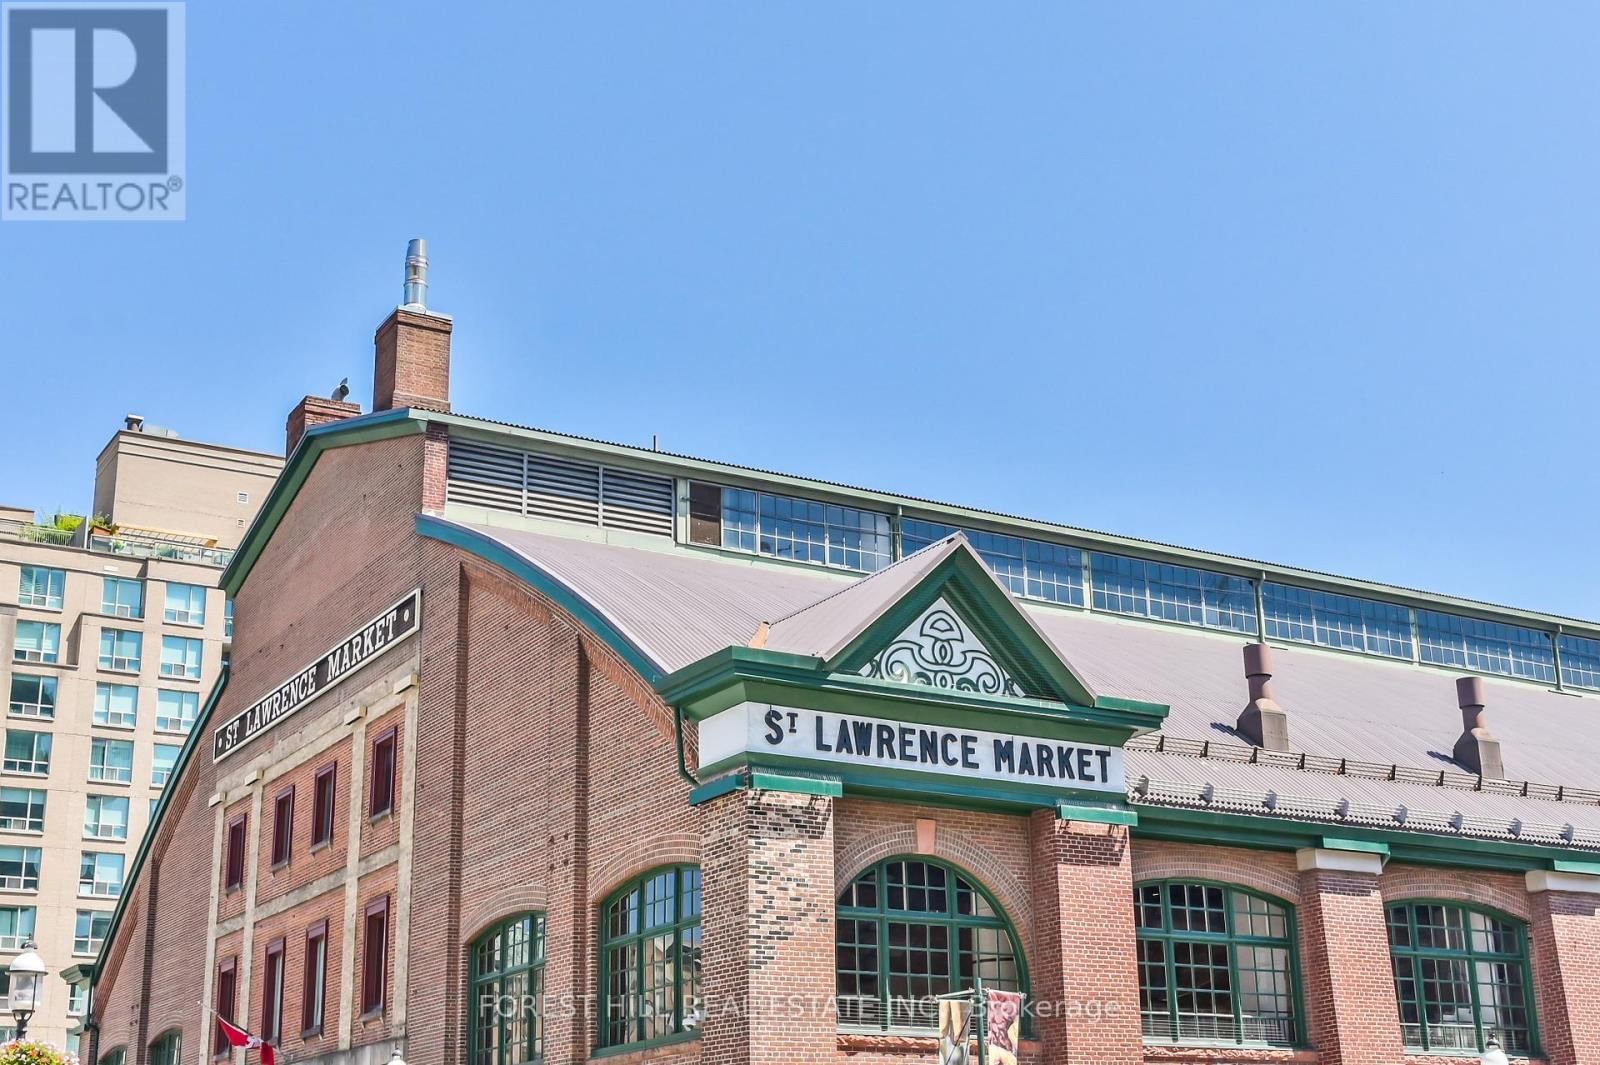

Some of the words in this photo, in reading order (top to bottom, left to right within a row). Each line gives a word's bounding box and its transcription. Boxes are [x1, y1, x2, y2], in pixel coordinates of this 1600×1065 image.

[246, 666, 317, 737] LAWRENCE
[327, 609, 397, 683] MARKET
[815, 715, 980, 770] LAWRENCE
[993, 739, 1112, 784] MARKET
